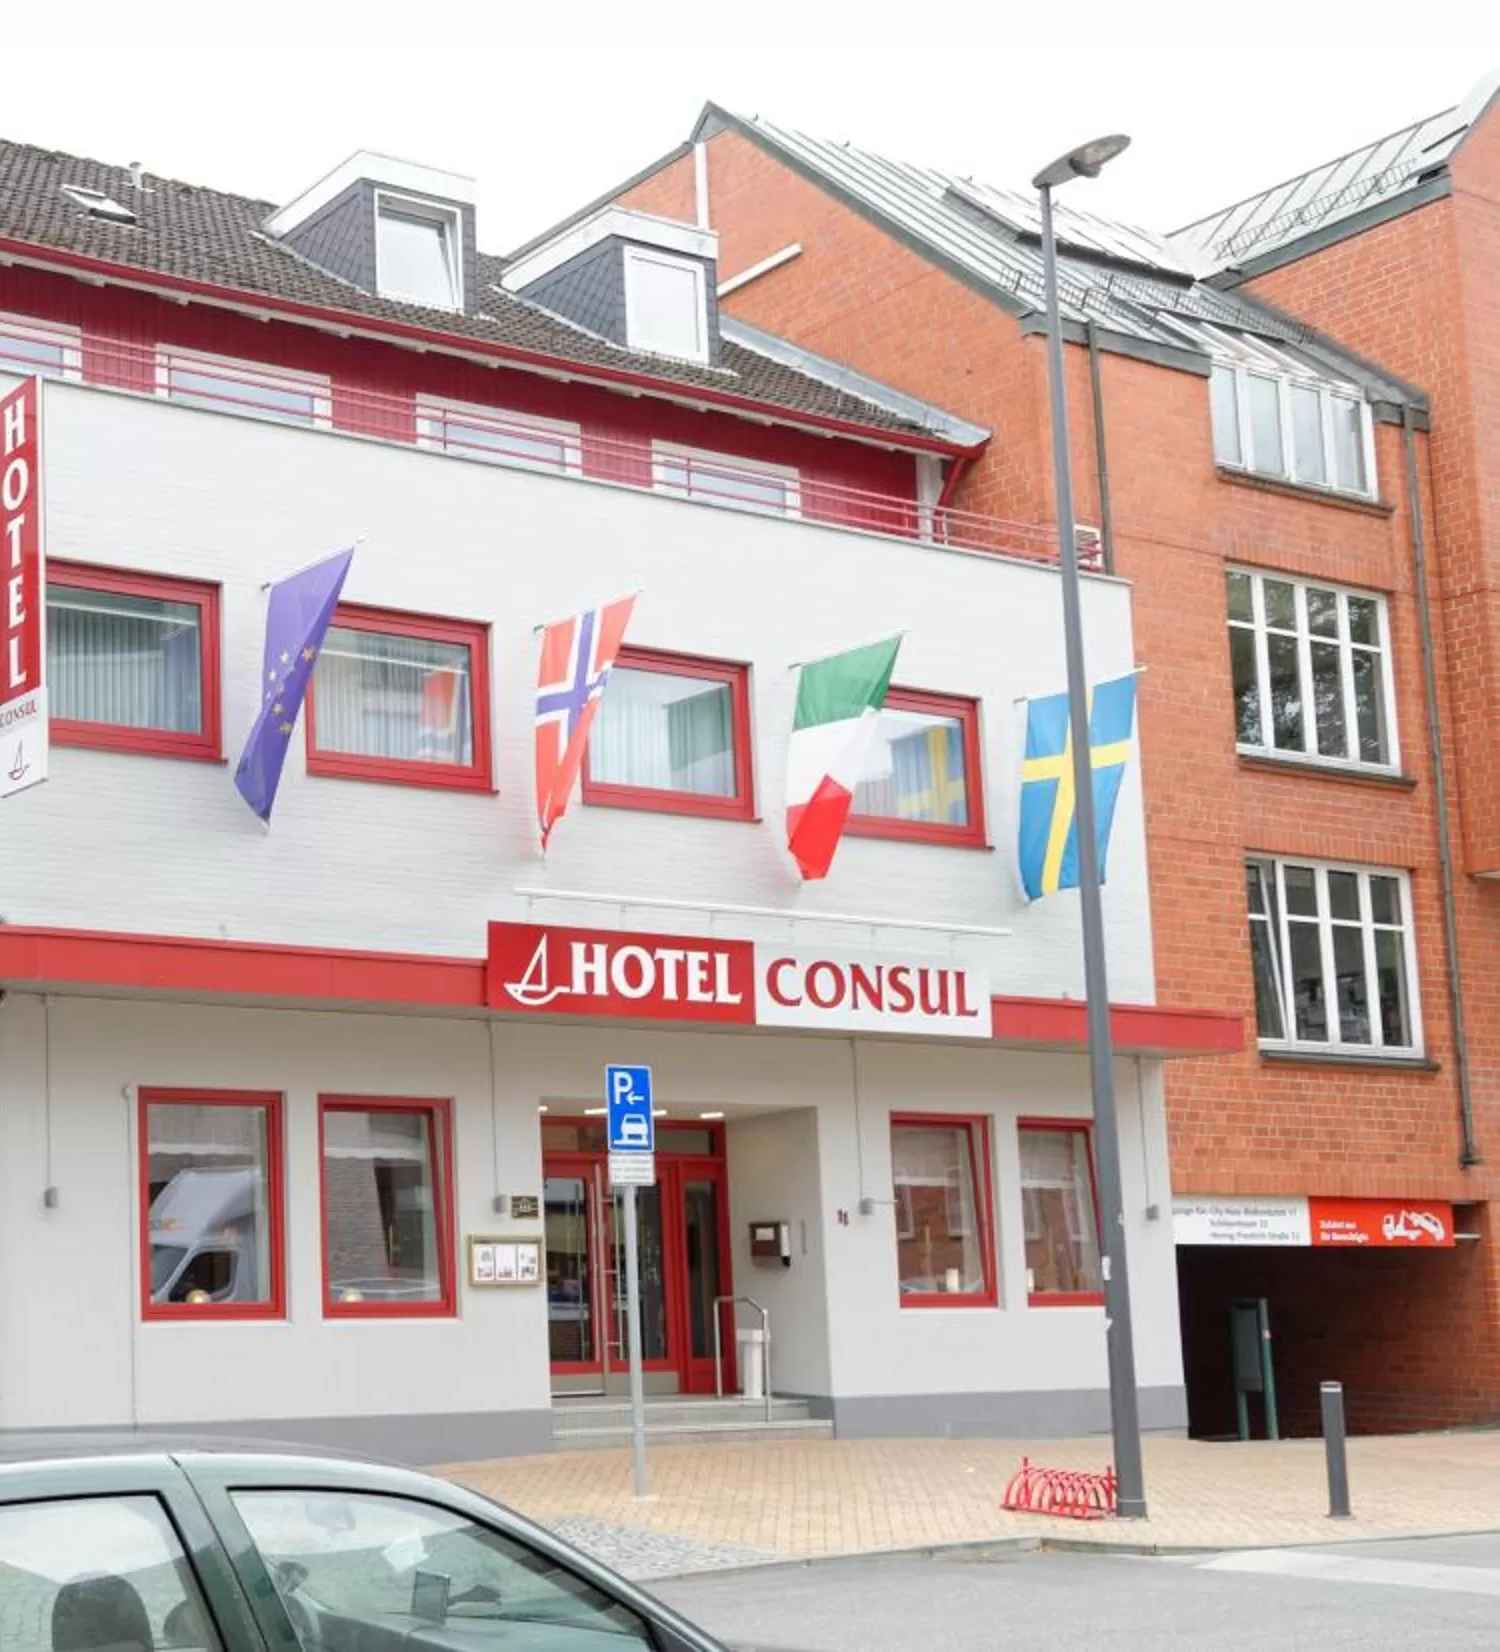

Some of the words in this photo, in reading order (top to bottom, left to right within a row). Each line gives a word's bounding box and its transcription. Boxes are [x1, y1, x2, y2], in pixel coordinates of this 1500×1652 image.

[2, 394, 30, 689] HOTEL
[569, 941, 742, 1004] HOTEL
[766, 957, 979, 1017] CONSUL
[613, 1071, 633, 1105] P
